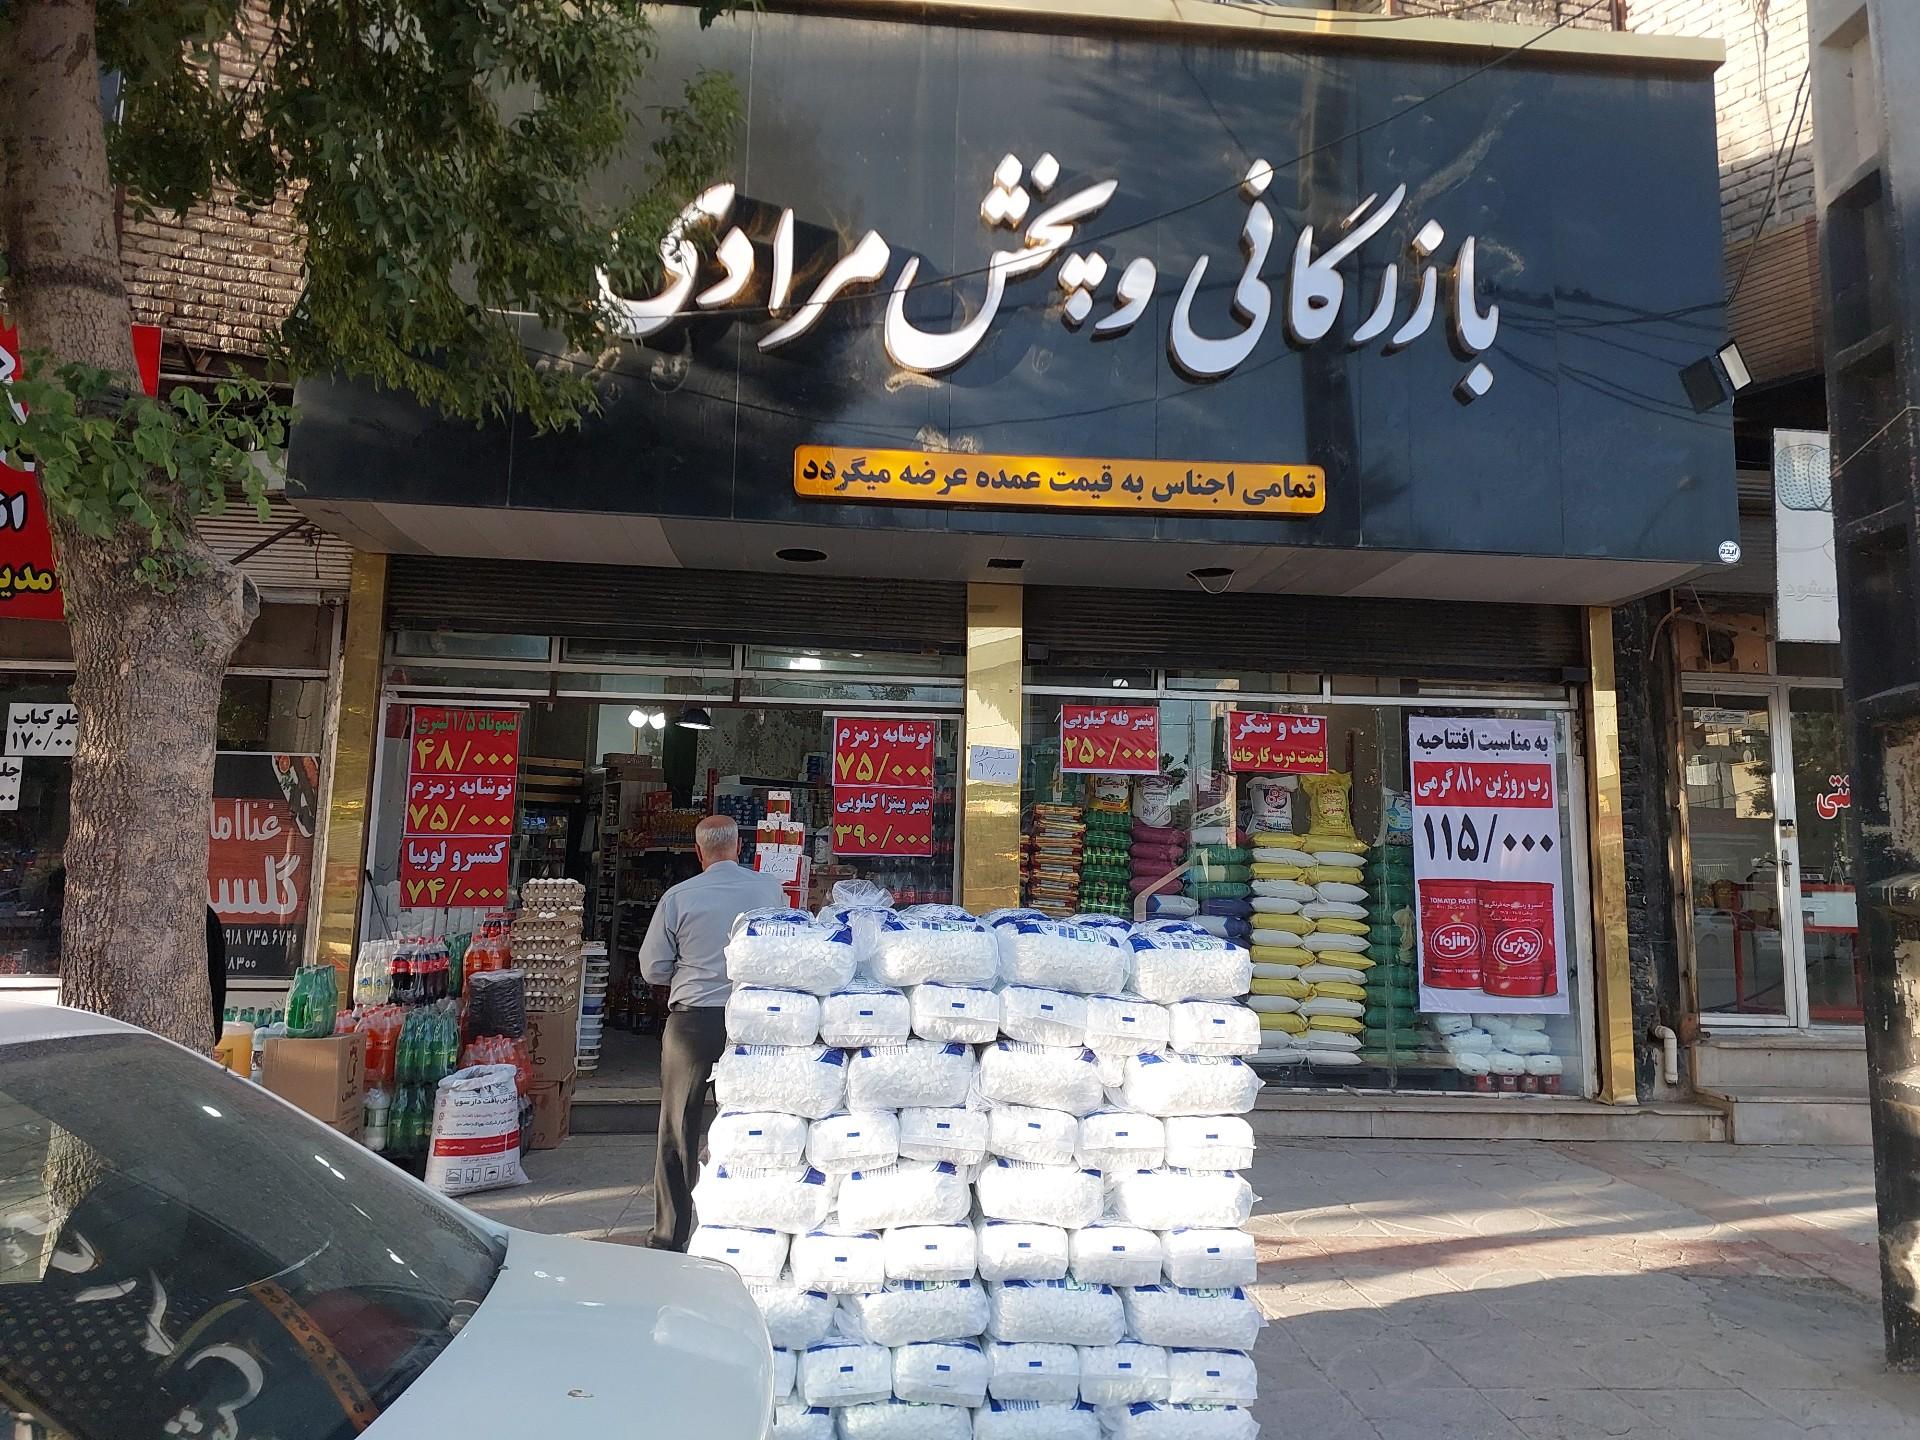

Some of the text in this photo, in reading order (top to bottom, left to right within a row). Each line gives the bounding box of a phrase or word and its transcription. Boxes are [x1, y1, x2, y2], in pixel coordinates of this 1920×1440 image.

[596, 182, 891, 353] مرادی
[1170, 158, 1499, 398] بازرگانی
[803, 456, 1317, 505] تمامی اجناس به قیمت عمده عرضه میگردد
[13, 708, 54, 729] کباب
[478, 712, 518, 736] لیموناد
[1064, 709, 1154, 731] پنیر فله کیلویی
[1234, 713, 1321, 741] قند و شکر
[839, 724, 932, 750] نوشابه زمزم
[1063, 736, 1157, 765] ۲۵۰/۰۰۰
[1416, 727, 1549, 757] به مناسبت افتتاحیه
[416, 738, 514, 771] ۴۸/۰۰۰
[836, 751, 932, 783] ۷۵/۰۰۰
[1272, 750, 1295, 768] درب
[1297, 746, 1324, 767] قیمت
[411, 776, 513, 800] نوشابه زمزم
[1417, 767, 1455, 798] گرمی
[1485, 770, 1526, 799] روژین
[1527, 776, 1550, 800] رب
[408, 803, 511, 832] ۷۵/۰۰۰
[836, 793, 930, 816] پنیر پیتزا کیلویی
[835, 824, 930, 849] ۳۹۰/۰۰۰
[1423, 812, 1554, 864] ۱۱۵/۰۰۰
[408, 840, 506, 871] کنسرو لوبیا
[206, 855, 301, 915] گلس
[406, 877, 504, 905] ۷۴/۰۰۰
[1430, 897, 1457, 905] TOMATO
[223, 928, 242, 945] ۹۱۸
[246, 929, 268, 945] ۷۳۵
[1439, 931, 1471, 950] rojin
[1500, 936, 1537, 958] روژین
[225, 956, 257, 970] ۸۳۰۰
